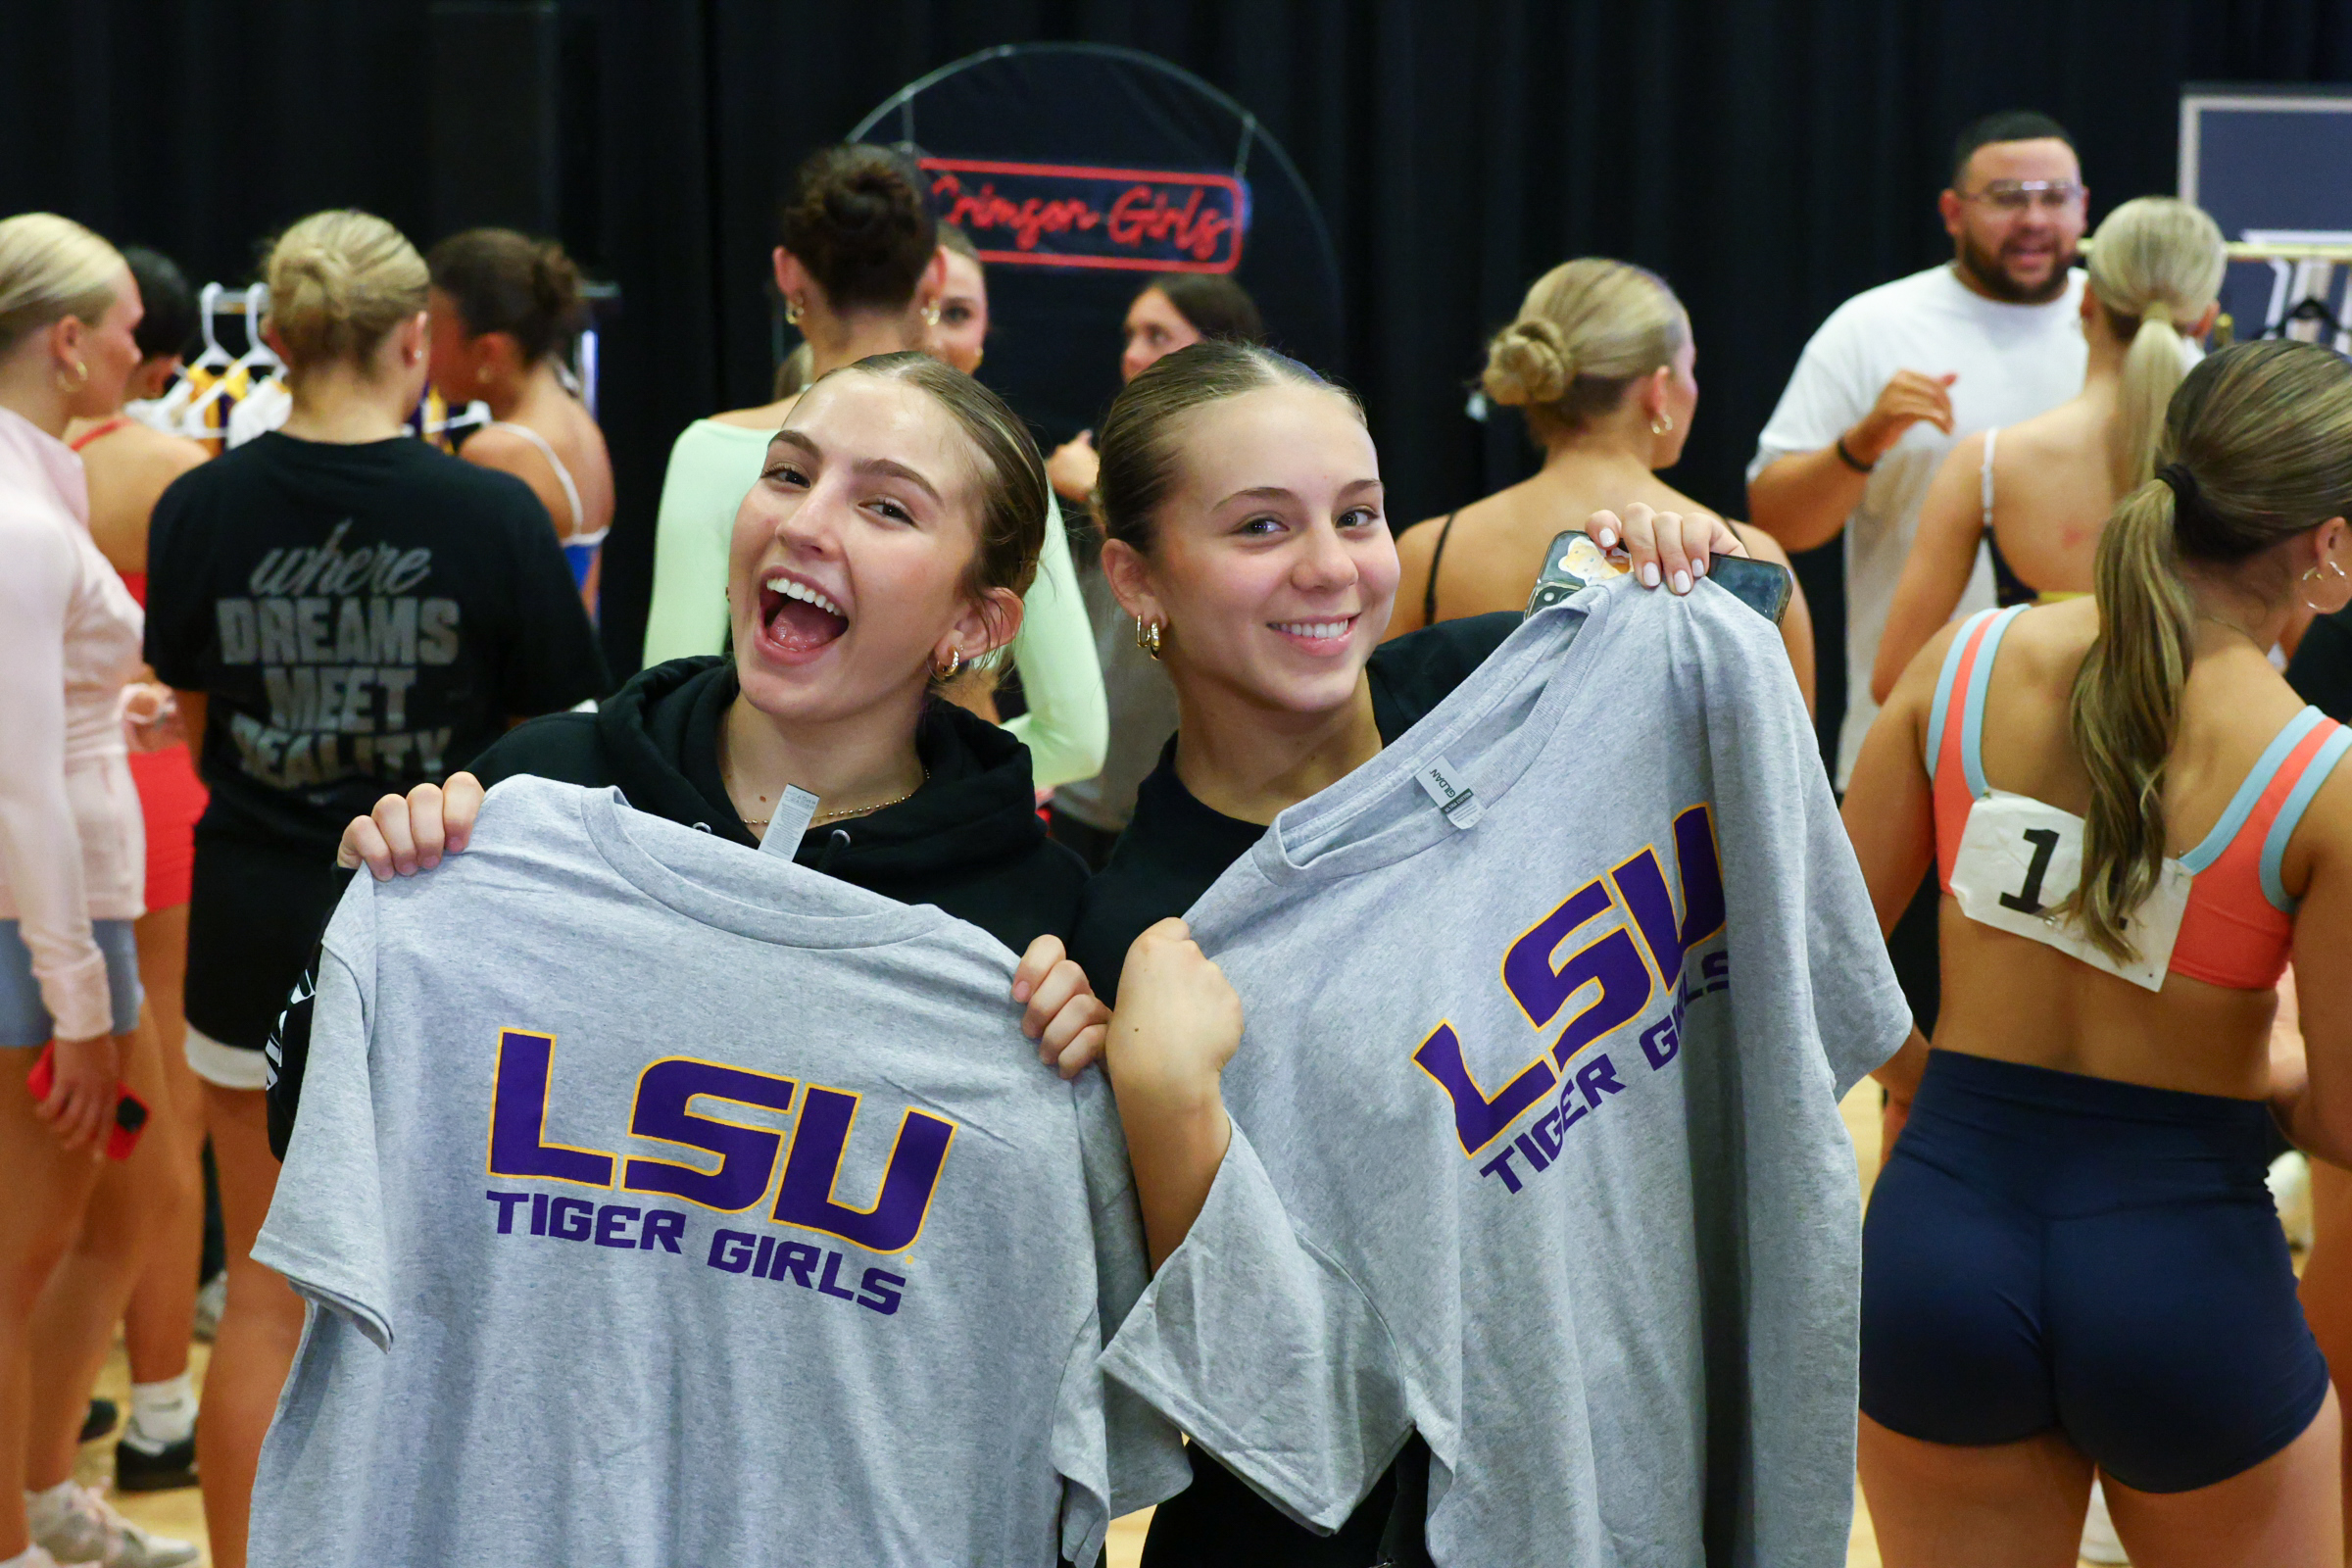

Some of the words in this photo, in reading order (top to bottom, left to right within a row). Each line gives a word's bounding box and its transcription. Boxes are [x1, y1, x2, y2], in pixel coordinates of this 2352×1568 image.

[1107, 185, 1232, 261] Girls
[249, 517, 432, 595] where
[216, 596, 461, 666] DREAMS
[263, 666, 417, 732] MEET
[1429, 768, 1456, 799] GILDAN
[1410, 802, 1726, 1159] LSU
[486, 1027, 959, 1255] LSU
[1479, 1054, 1627, 1195] TIGER
[486, 1190, 686, 1254] TIGER
[707, 1229, 906, 1315] GIRLS
